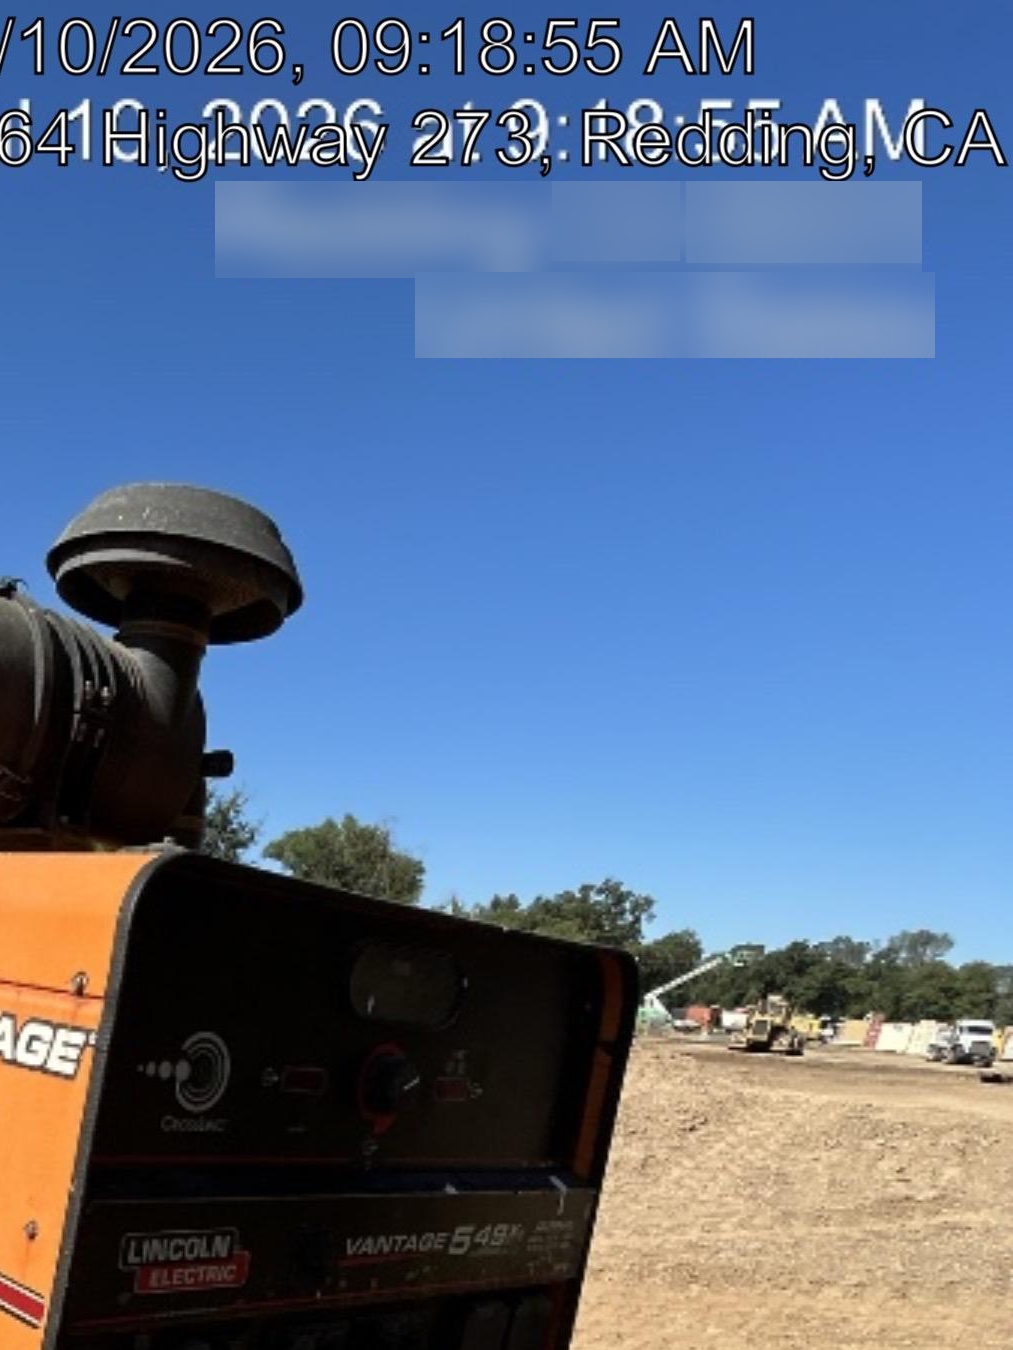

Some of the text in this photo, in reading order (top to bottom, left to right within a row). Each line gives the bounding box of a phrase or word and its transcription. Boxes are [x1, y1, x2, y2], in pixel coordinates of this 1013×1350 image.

[127, 1234, 231, 1264] LINCOLN
[346, 1231, 448, 1256] VANTAGE
[147, 1264, 238, 1288] ELECTRIC
